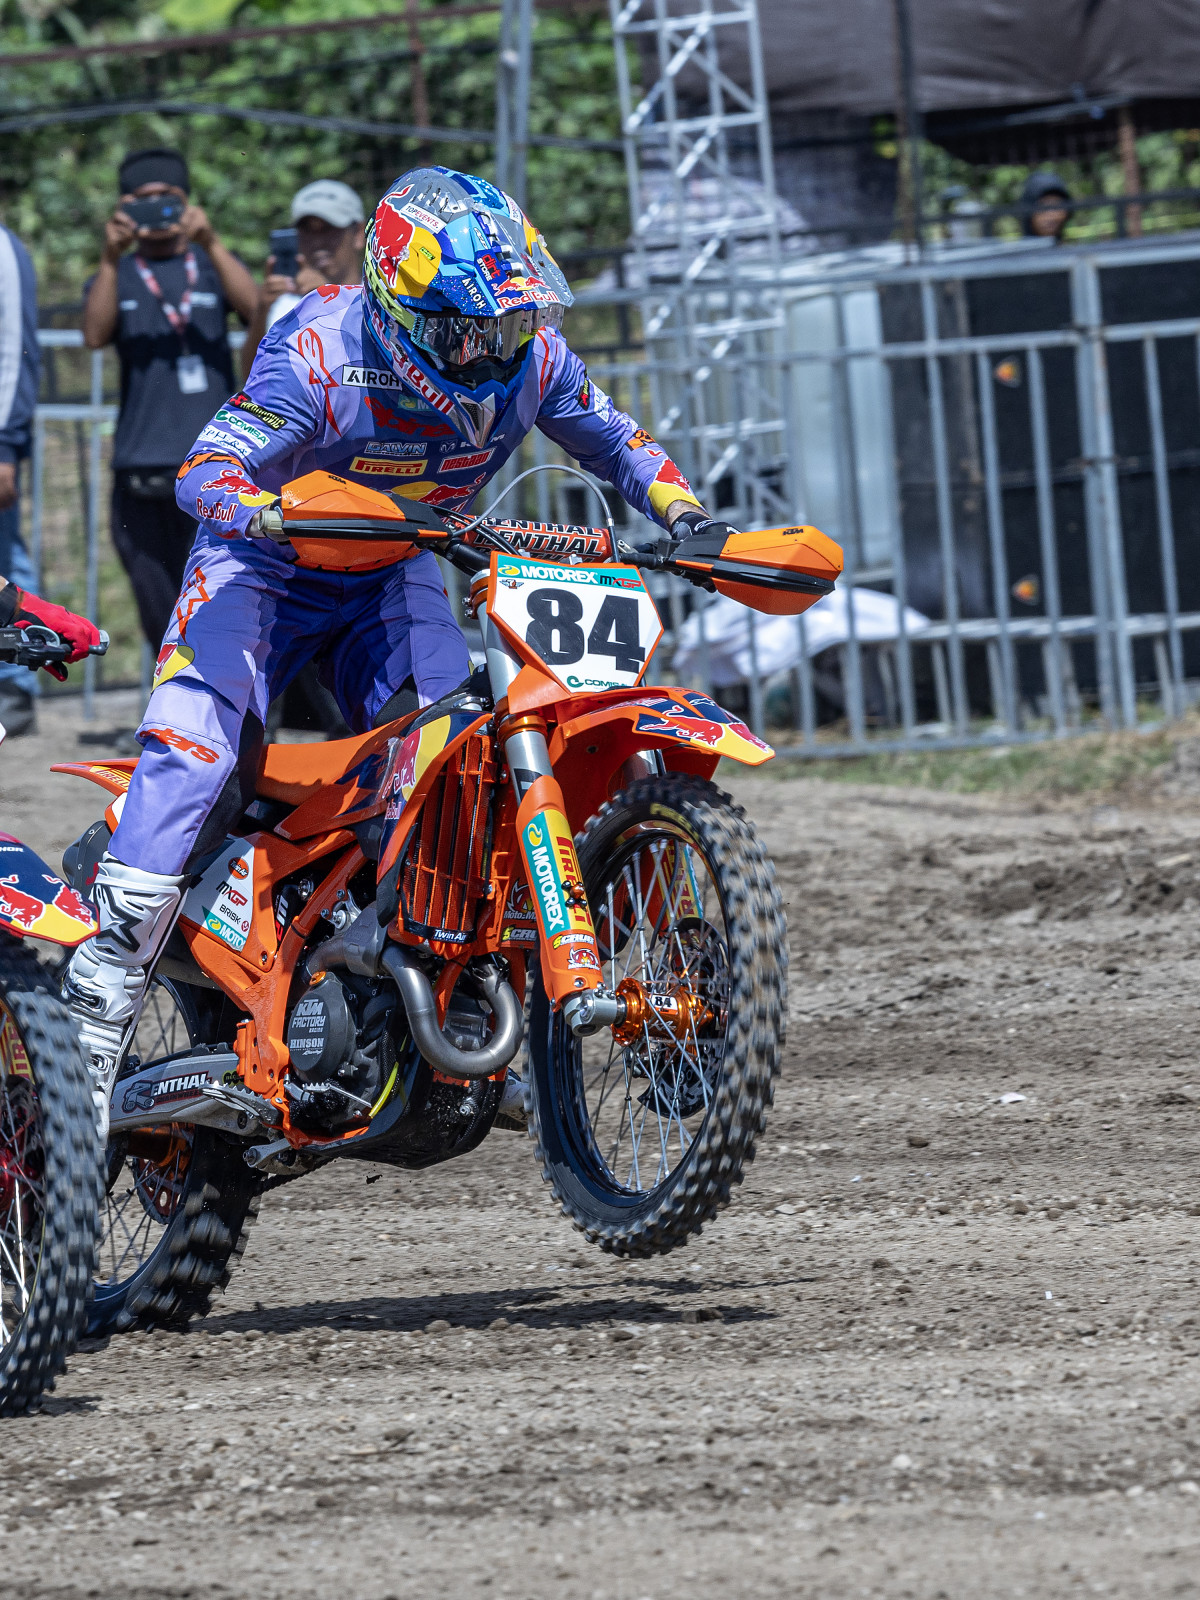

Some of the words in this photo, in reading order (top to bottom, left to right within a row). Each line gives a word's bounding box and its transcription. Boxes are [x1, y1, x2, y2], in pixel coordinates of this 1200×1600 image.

[476, 259, 493, 282] STORE
[482, 254, 501, 279] dirt
[462, 278, 486, 310] AIROH
[497, 294, 532, 310] Red
[532, 291, 560, 304] Bull
[228, 415, 268, 445] COMISA
[355, 459, 424, 474] PIRELLI
[197, 497, 215, 519] Red
[214, 502, 238, 523] Bull
[783, 528, 803, 536] KTM
[521, 565, 598, 585] MOTOREX
[600, 575, 642, 589] MXGP
[526, 587, 646, 674] 84
[216, 881, 249, 906] MXGP
[532, 846, 564, 932] MOTOREX
[219, 904, 241, 925] BRISK
[434, 928, 455, 940] Twin
[454, 931, 467, 942] Air
[553, 933, 595, 950] SCRUB
[296, 999, 324, 1016] KTM
[655, 996, 672, 1008] 84
[292, 1015, 326, 1029] FACTORY
[290, 1038, 324, 1050] HINSON
